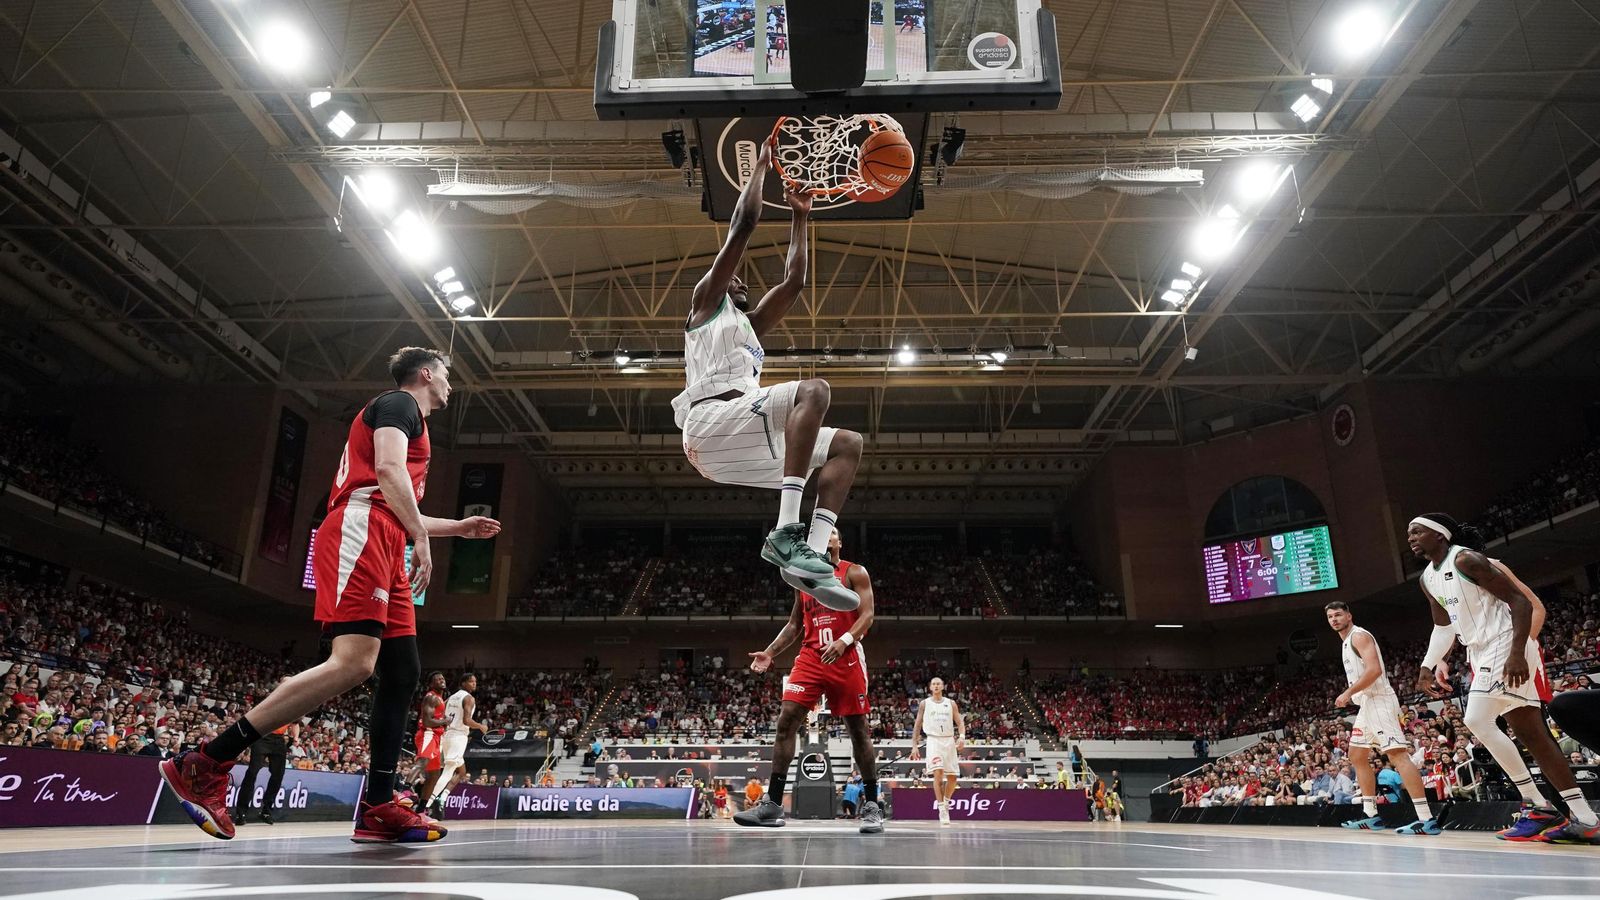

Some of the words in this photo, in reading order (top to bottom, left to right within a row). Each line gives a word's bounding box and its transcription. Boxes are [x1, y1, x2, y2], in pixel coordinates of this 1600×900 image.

[738, 144, 751, 177] Murcia
[1248, 559, 1255, 569] 7
[1257, 567, 1278, 577] 6:00
[34, 773, 64, 803] Tu
[64, 777, 118, 802] tren
[289, 780, 308, 809] da
[446, 789, 470, 815] renfe
[517, 794, 570, 812] Nadie
[575, 796, 593, 812] te
[598, 794, 620, 812] da
